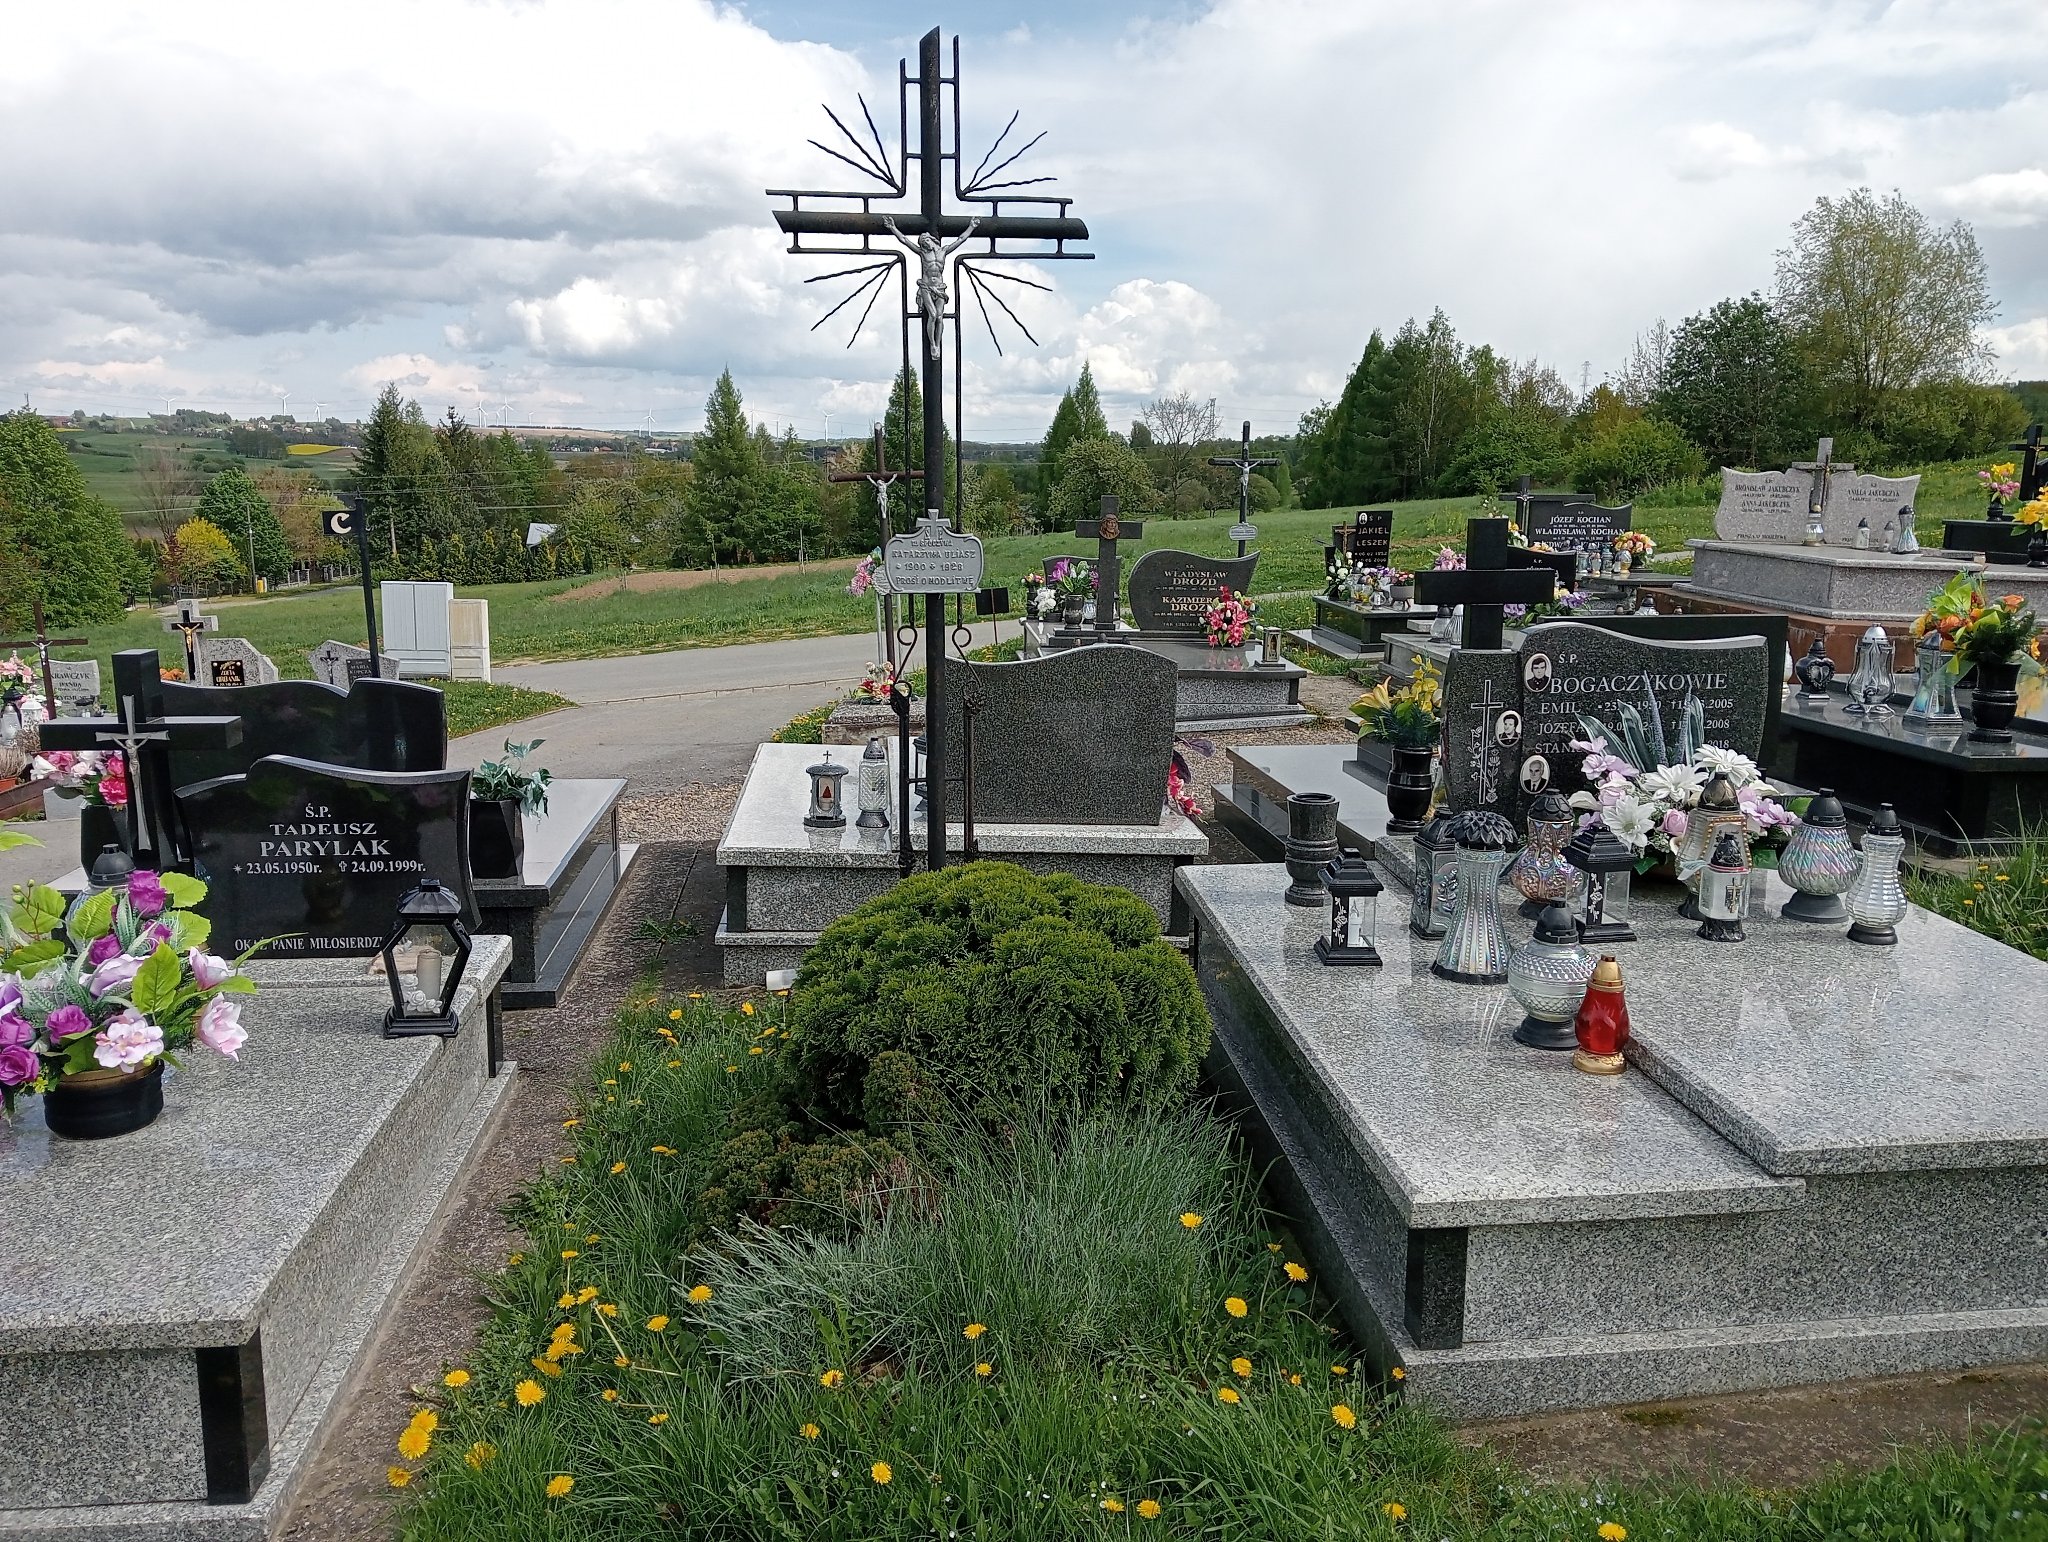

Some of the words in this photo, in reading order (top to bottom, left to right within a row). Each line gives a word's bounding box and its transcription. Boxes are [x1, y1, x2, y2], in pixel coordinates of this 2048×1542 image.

[331, 512, 351, 534] C
[1550, 516, 1574, 524] JÓZEF
[1550, 673, 1728, 694] BOGACZYKOWIE
[1541, 702, 1581, 714] EMIL
[1538, 720, 1585, 735] JÓZEFA
[305, 802, 332, 818] Ś.P.
[270, 823, 377, 836] TADEUSZ
[260, 840, 391, 857] PARYLAK
[246, 862, 323, 874] 23.05.1950r.
[352, 860, 426, 873] 24.09.1999r.
[272, 938, 304, 950] PANIE
[310, 937, 383, 949] MIŁOSIERDZ
